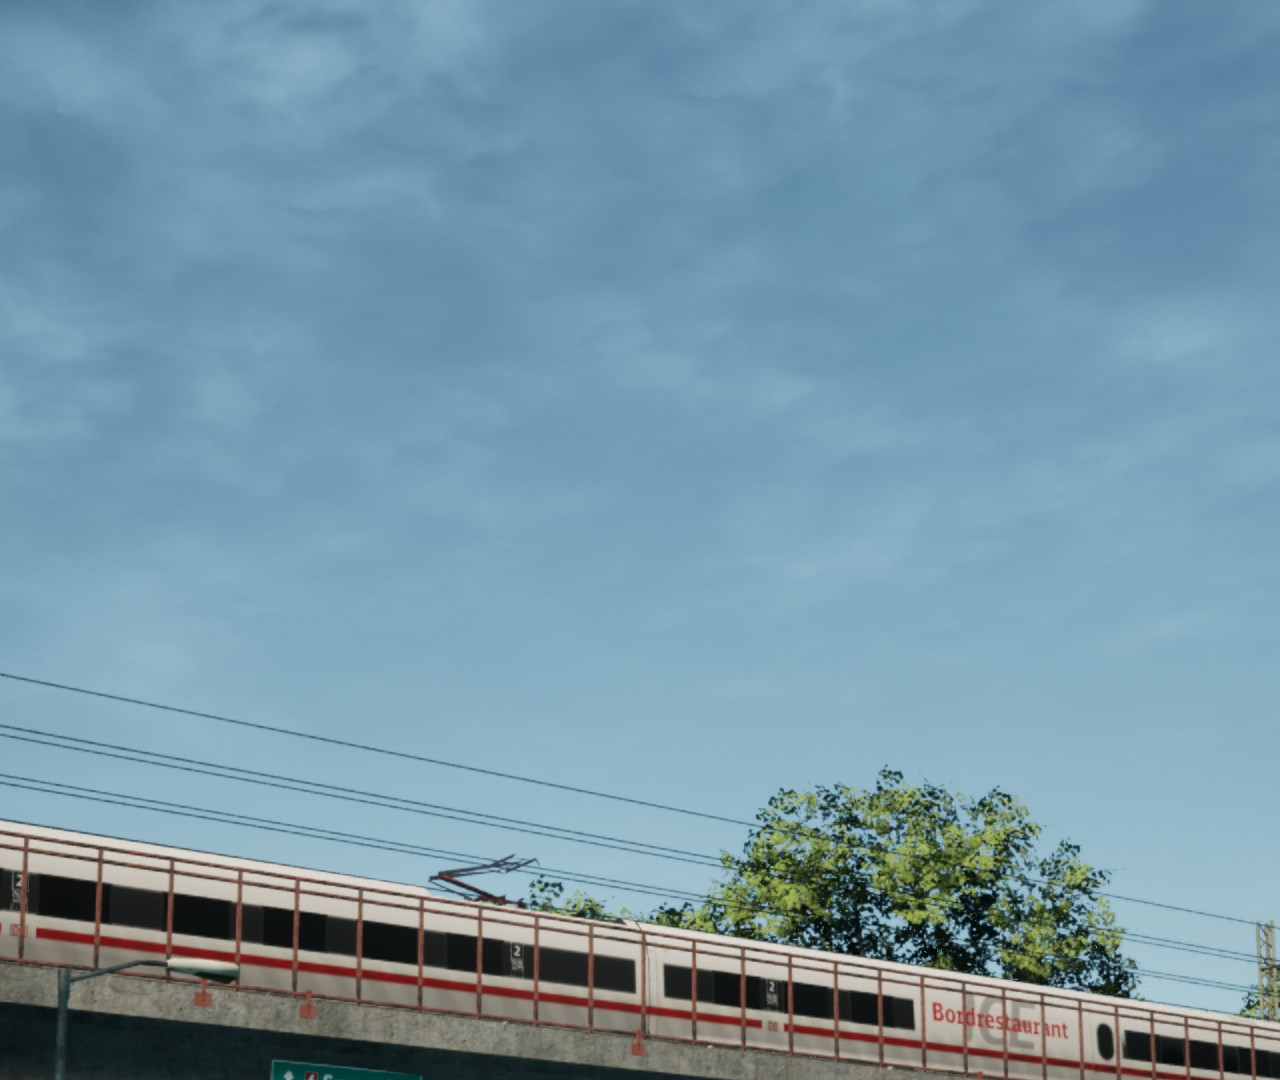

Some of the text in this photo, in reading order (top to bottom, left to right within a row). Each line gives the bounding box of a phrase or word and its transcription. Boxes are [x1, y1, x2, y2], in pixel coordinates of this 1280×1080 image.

[513, 945, 521, 957] 2
[768, 981, 776, 992] 2
[931, 1002, 1068, 1039] Bordrestaurant
